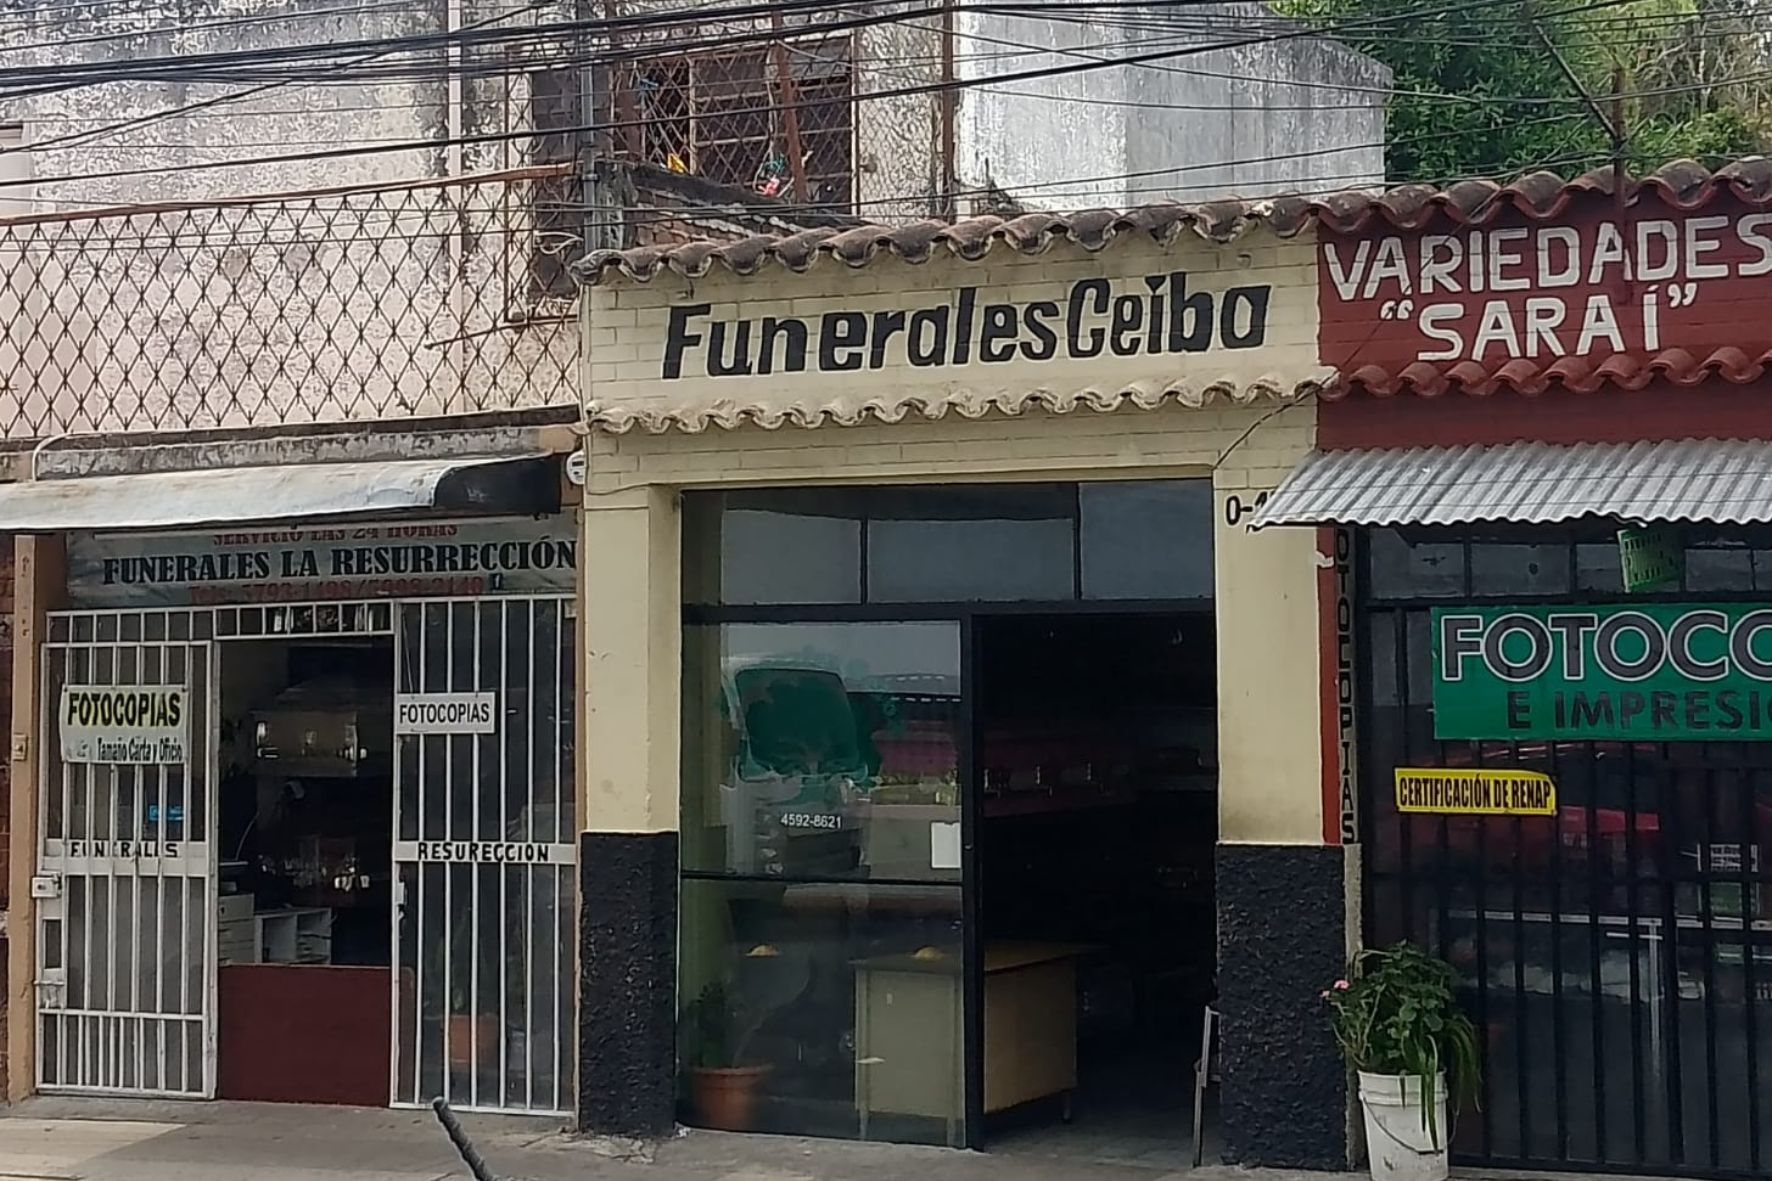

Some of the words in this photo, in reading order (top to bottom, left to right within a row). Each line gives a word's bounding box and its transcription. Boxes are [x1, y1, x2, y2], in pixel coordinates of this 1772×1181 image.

[1324, 213, 1772, 300] VARIEDADES
[660, 286, 1059, 381] Funerales
[1065, 271, 1273, 359] Ceiba
[102, 550, 271, 585] FUNERALES
[281, 550, 319, 578] LA
[330, 535, 577, 576] RESURRECCIÓN
[67, 692, 181, 727] FOTOCOPIAS
[400, 703, 490, 724] FOTOCOPIAS
[1506, 690, 1532, 730] E
[1554, 689, 1772, 731] IMPRESI
[1400, 773, 1491, 808] CERTIFICACIÓN
[1493, 779, 1509, 808] DE
[1512, 780, 1551, 809] RENAP
[780, 813, 841, 829] 4592-8621
[417, 842, 550, 862] RESURECCION
